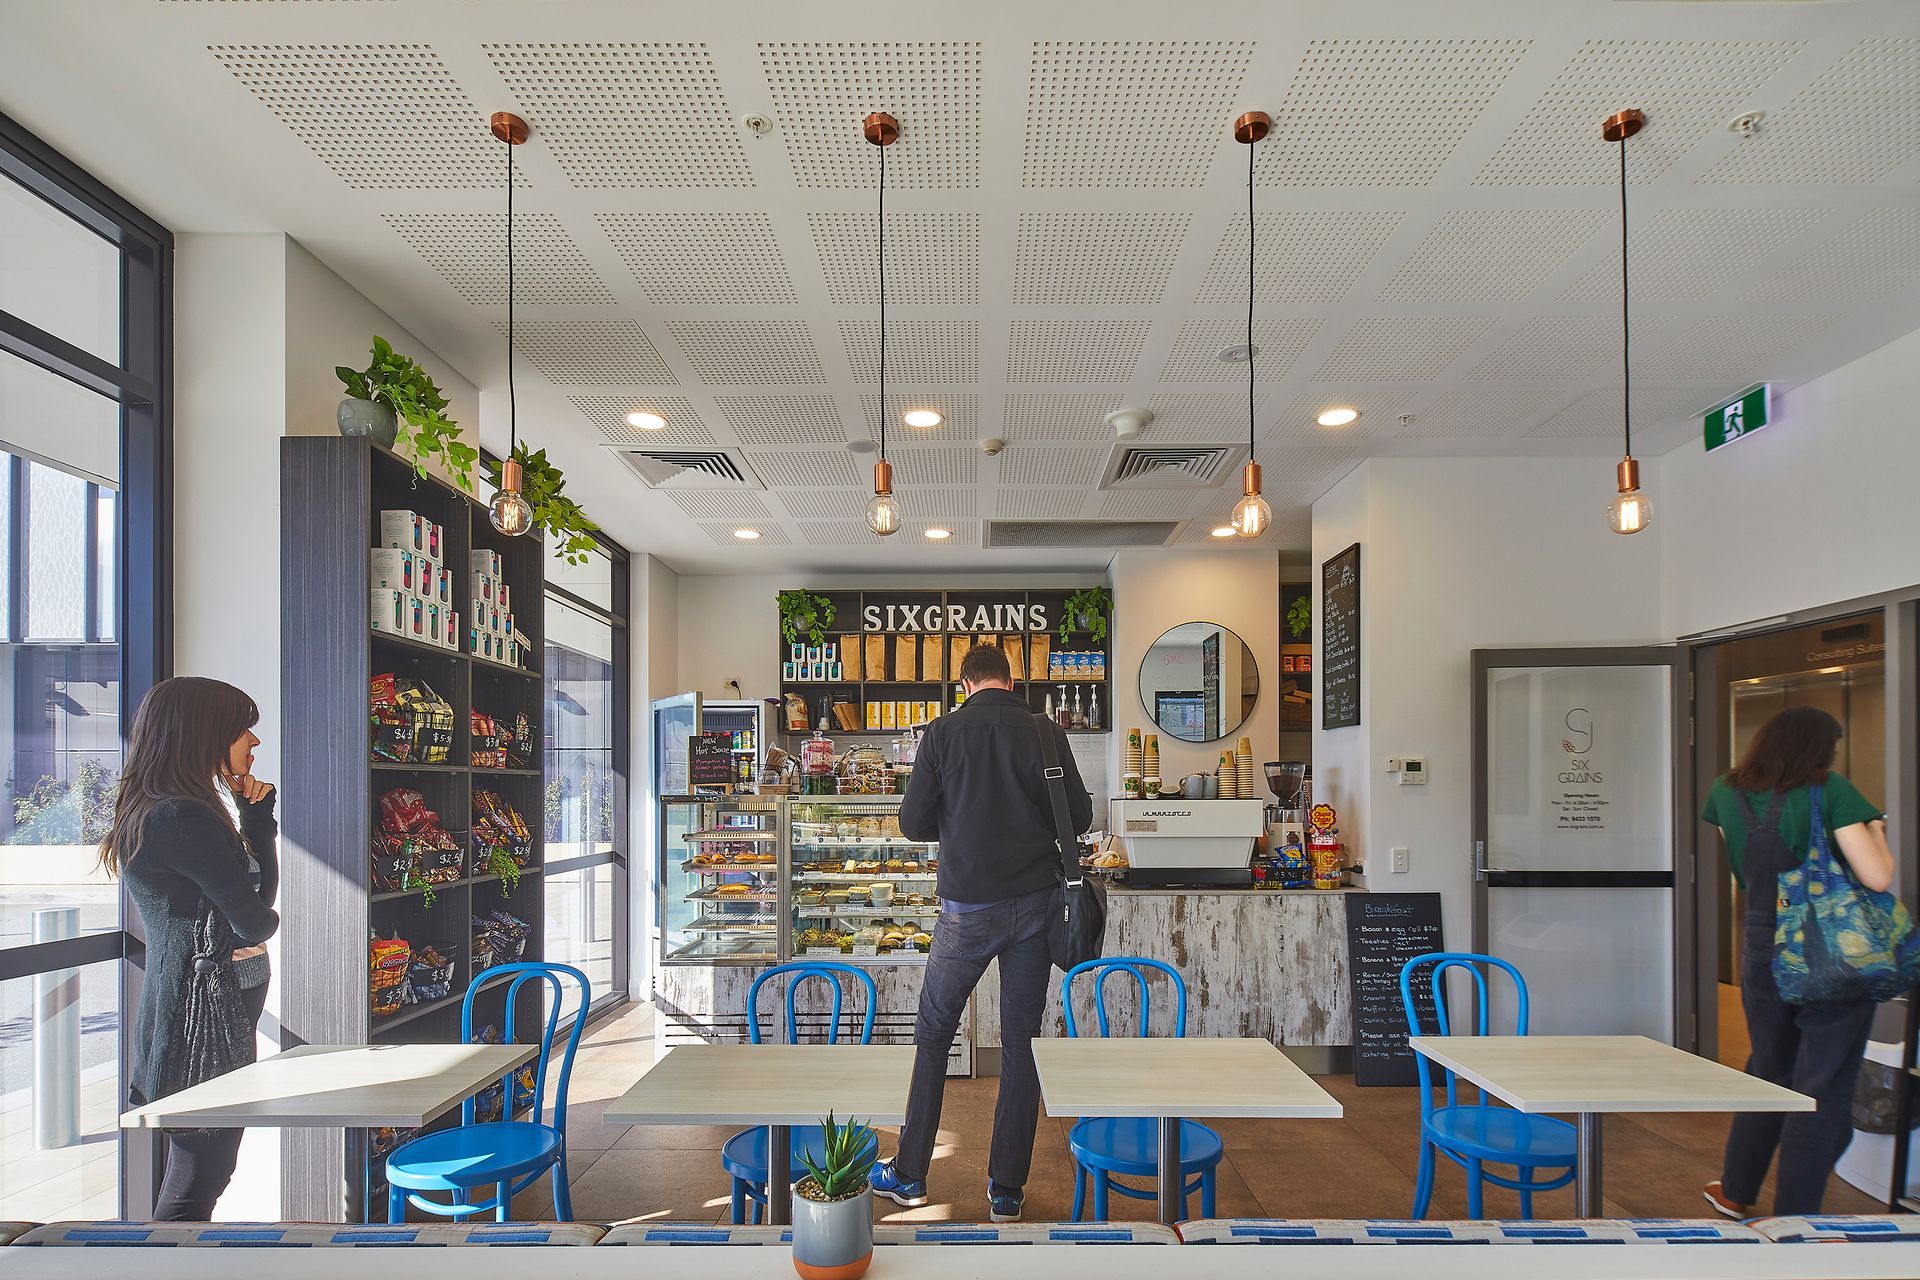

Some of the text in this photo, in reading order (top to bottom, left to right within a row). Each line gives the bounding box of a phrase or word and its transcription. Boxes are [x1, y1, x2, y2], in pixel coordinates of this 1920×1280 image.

[863, 604, 1048, 632] SIXGRAINS
[1806, 648, 1855, 662] Consulting
[1571, 759, 1590, 771] SIX
[1558, 771, 1604, 784] GRAINS
[1364, 903, 1414, 915] Breakfast
[1391, 926, 1406, 936] egg
